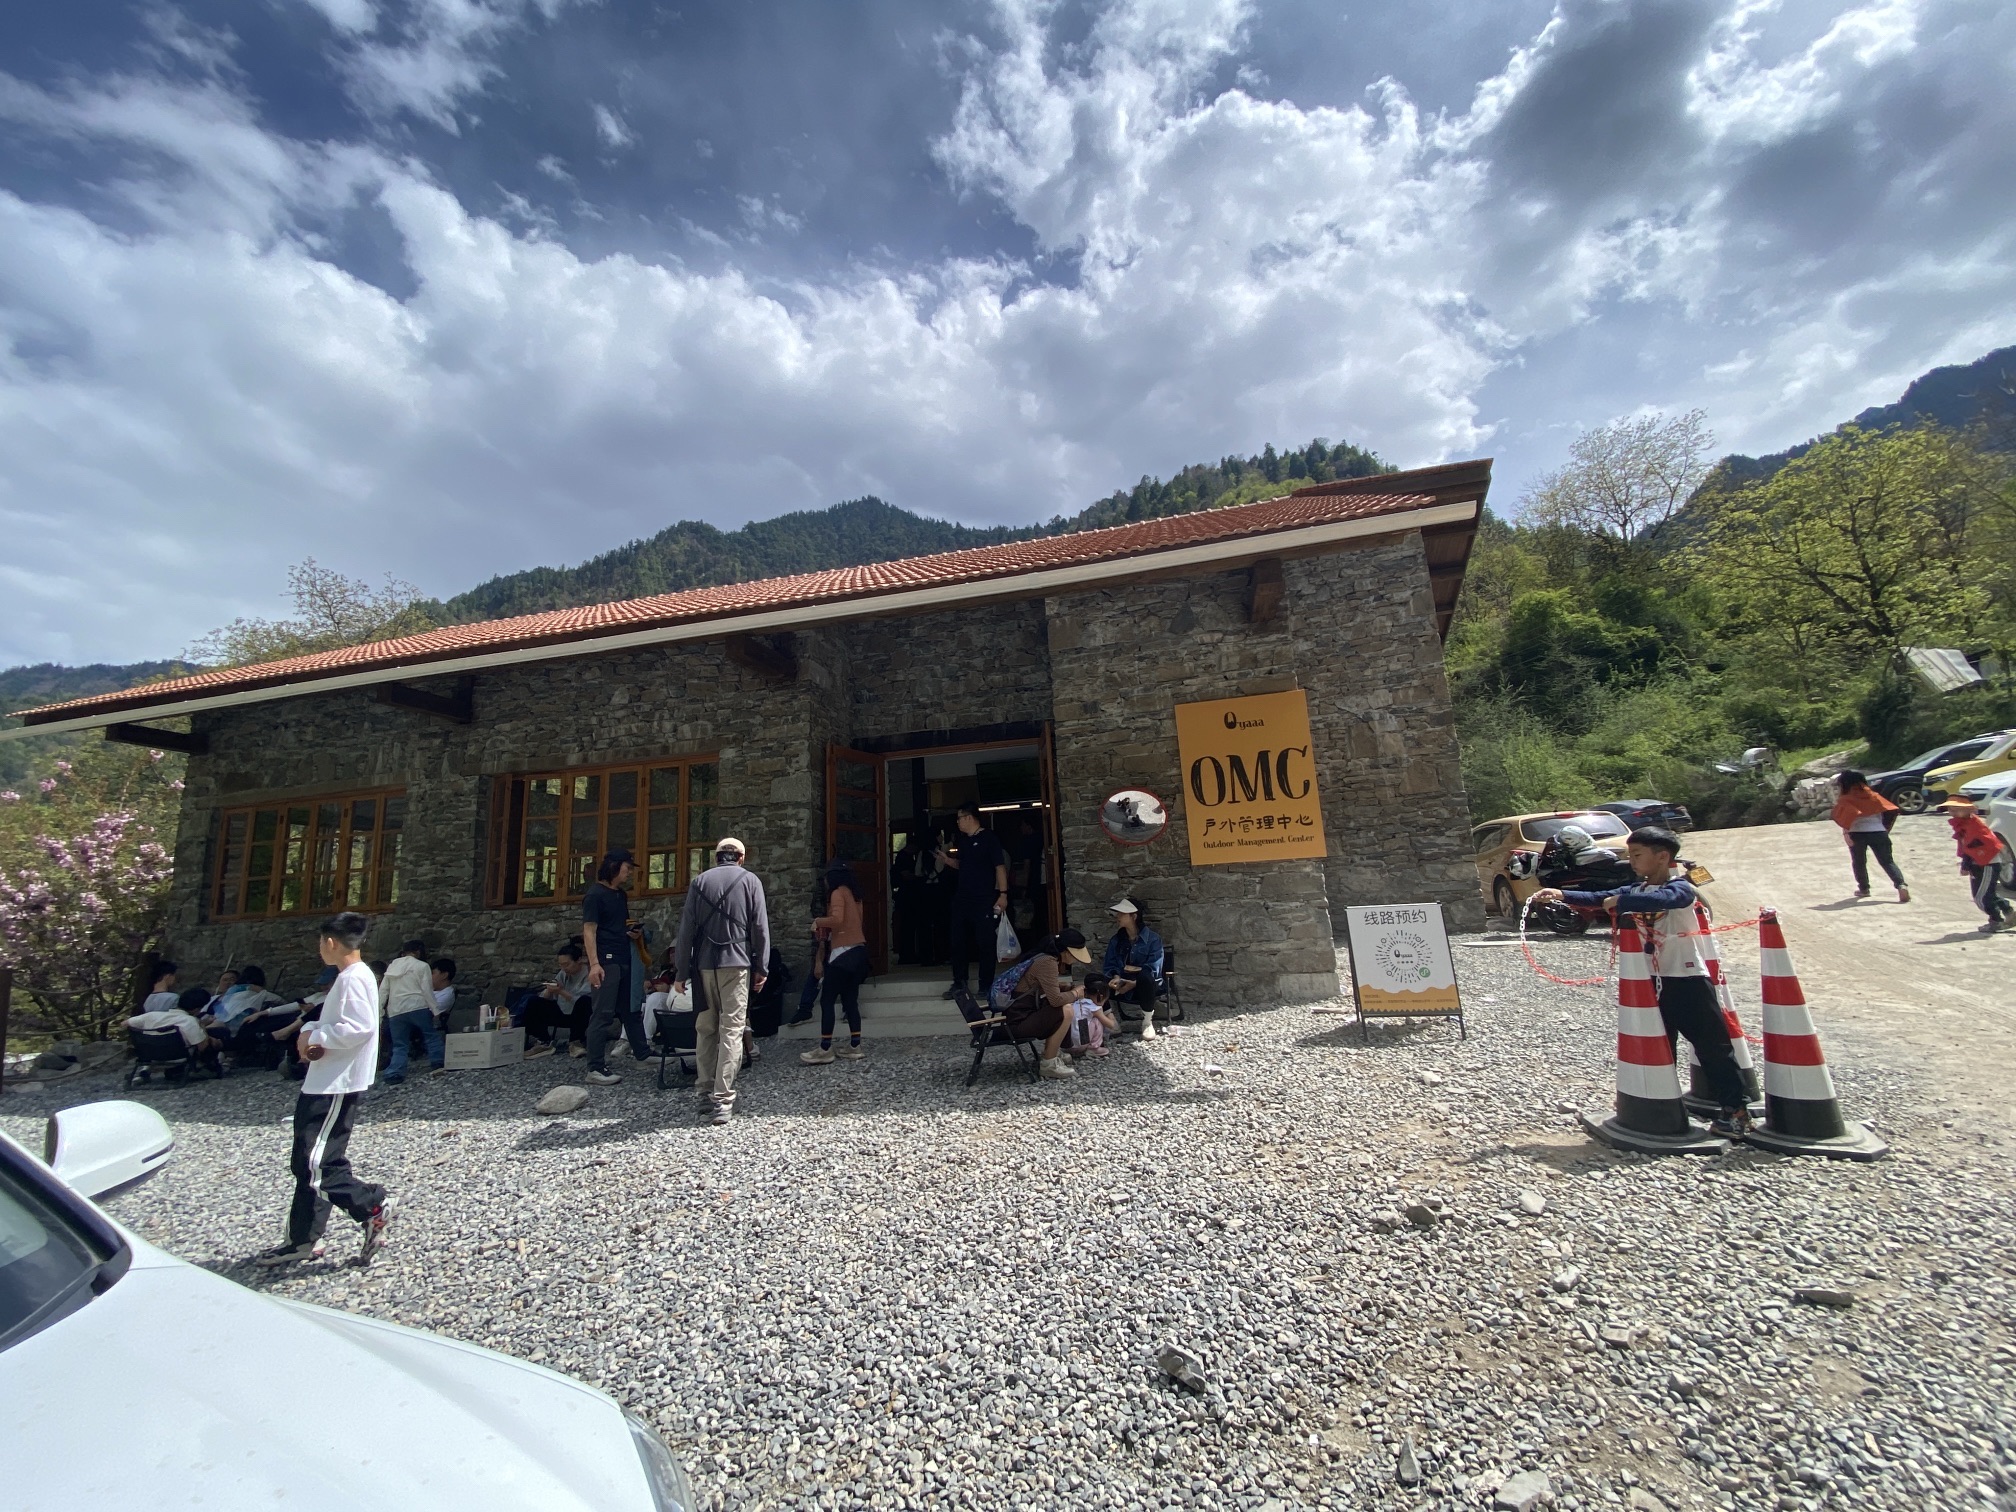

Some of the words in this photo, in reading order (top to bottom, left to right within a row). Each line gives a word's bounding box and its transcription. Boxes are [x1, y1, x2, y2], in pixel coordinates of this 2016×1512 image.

[1224, 711, 1264, 730] Oyaaa
[1190, 745, 1310, 807] OMC
[1203, 840, 1235, 848] Outdoor
[1237, 836, 1286, 847] Management
[1288, 835, 1315, 843] Center
[1364, 909, 1427, 926] 线路预约
